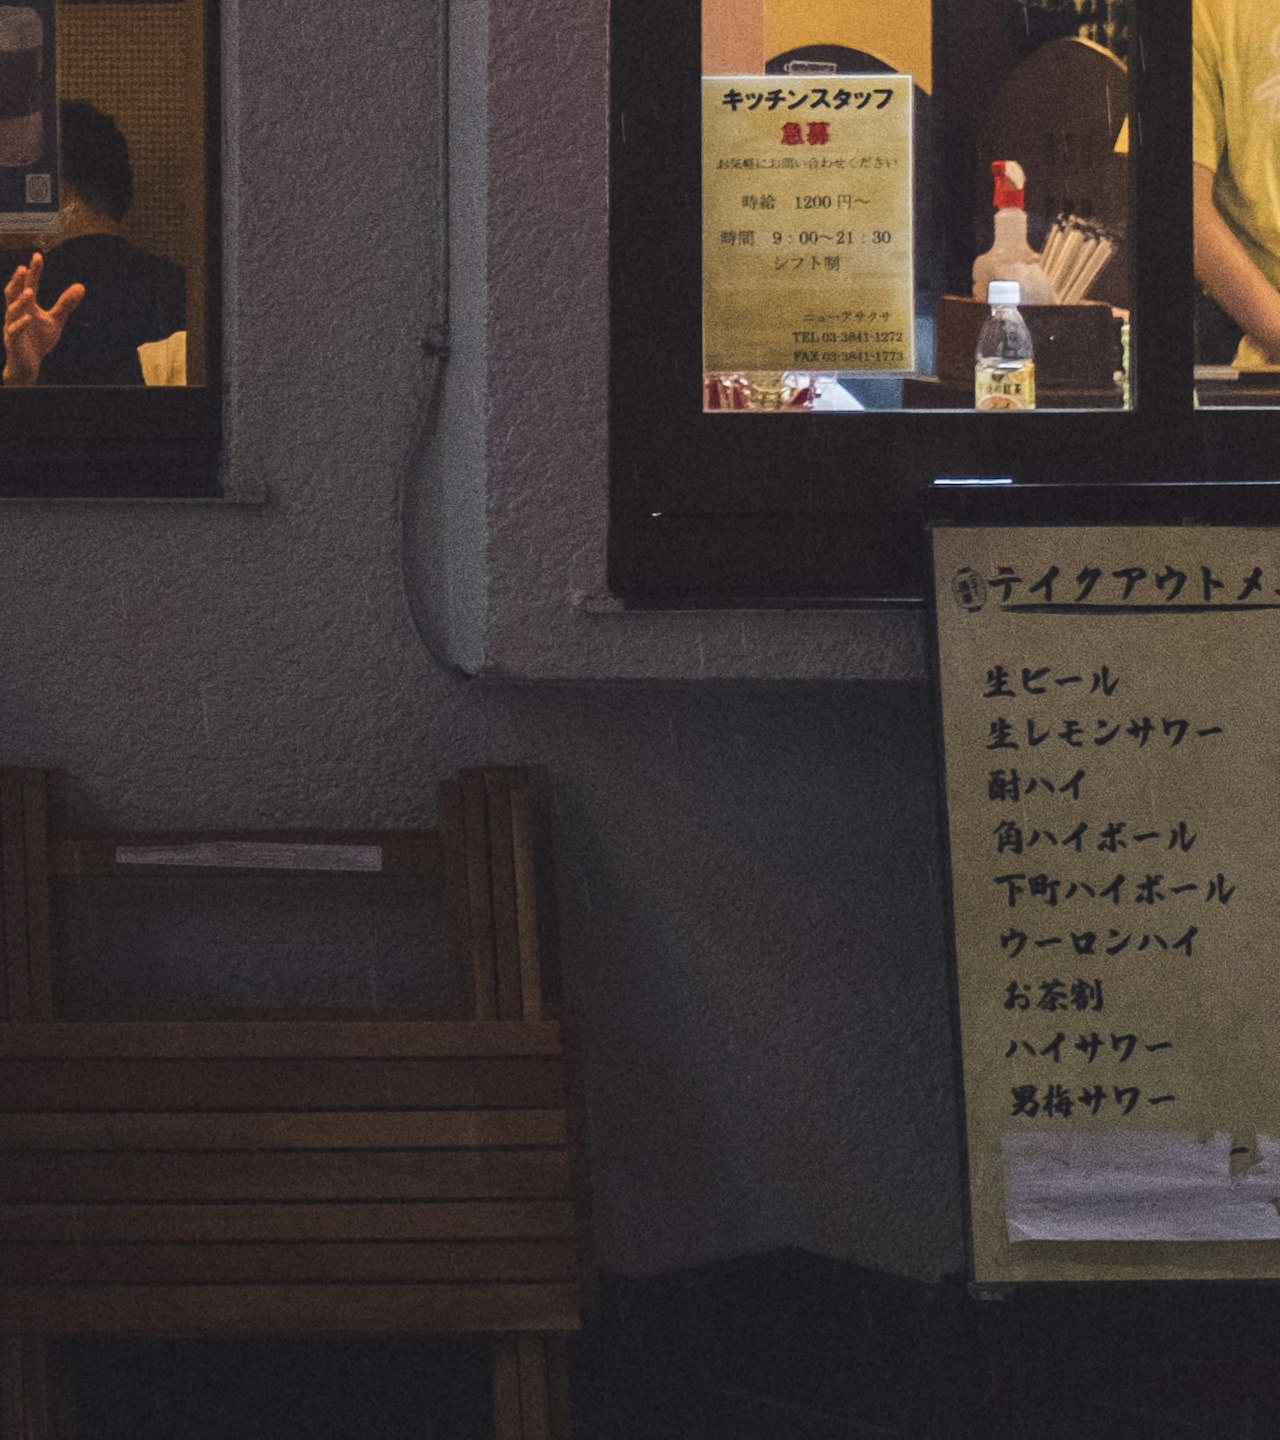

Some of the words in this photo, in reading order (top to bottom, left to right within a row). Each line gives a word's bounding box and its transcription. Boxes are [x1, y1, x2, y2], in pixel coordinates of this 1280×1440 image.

[722, 88, 893, 111] キッチンスタッフ
[781, 122, 831, 145] 急募
[716, 157, 898, 170] お気軽にお問い合わせください
[741, 195, 775, 210] 時給
[720, 230, 755, 246] 時間
[792, 332, 820, 343] TEL
[793, 351, 820, 362] FAX
[988, 565, 1280, 602] テイクアウトメ
[983, 664, 1120, 698] 生ビール
[986, 716, 1223, 750] 生レモンサワー
[987, 768, 1086, 802] 酎ハイ
[993, 820, 1197, 854] 角ハイボール
[993, 873, 1236, 907] 下町ハイボール
[1000, 924, 1199, 958] ウーロンハイ
[1003, 978, 1104, 1012] お茶割
[1005, 1031, 1173, 1063] ハイサワー
[1010, 1084, 1176, 1118] 男梅サワー
